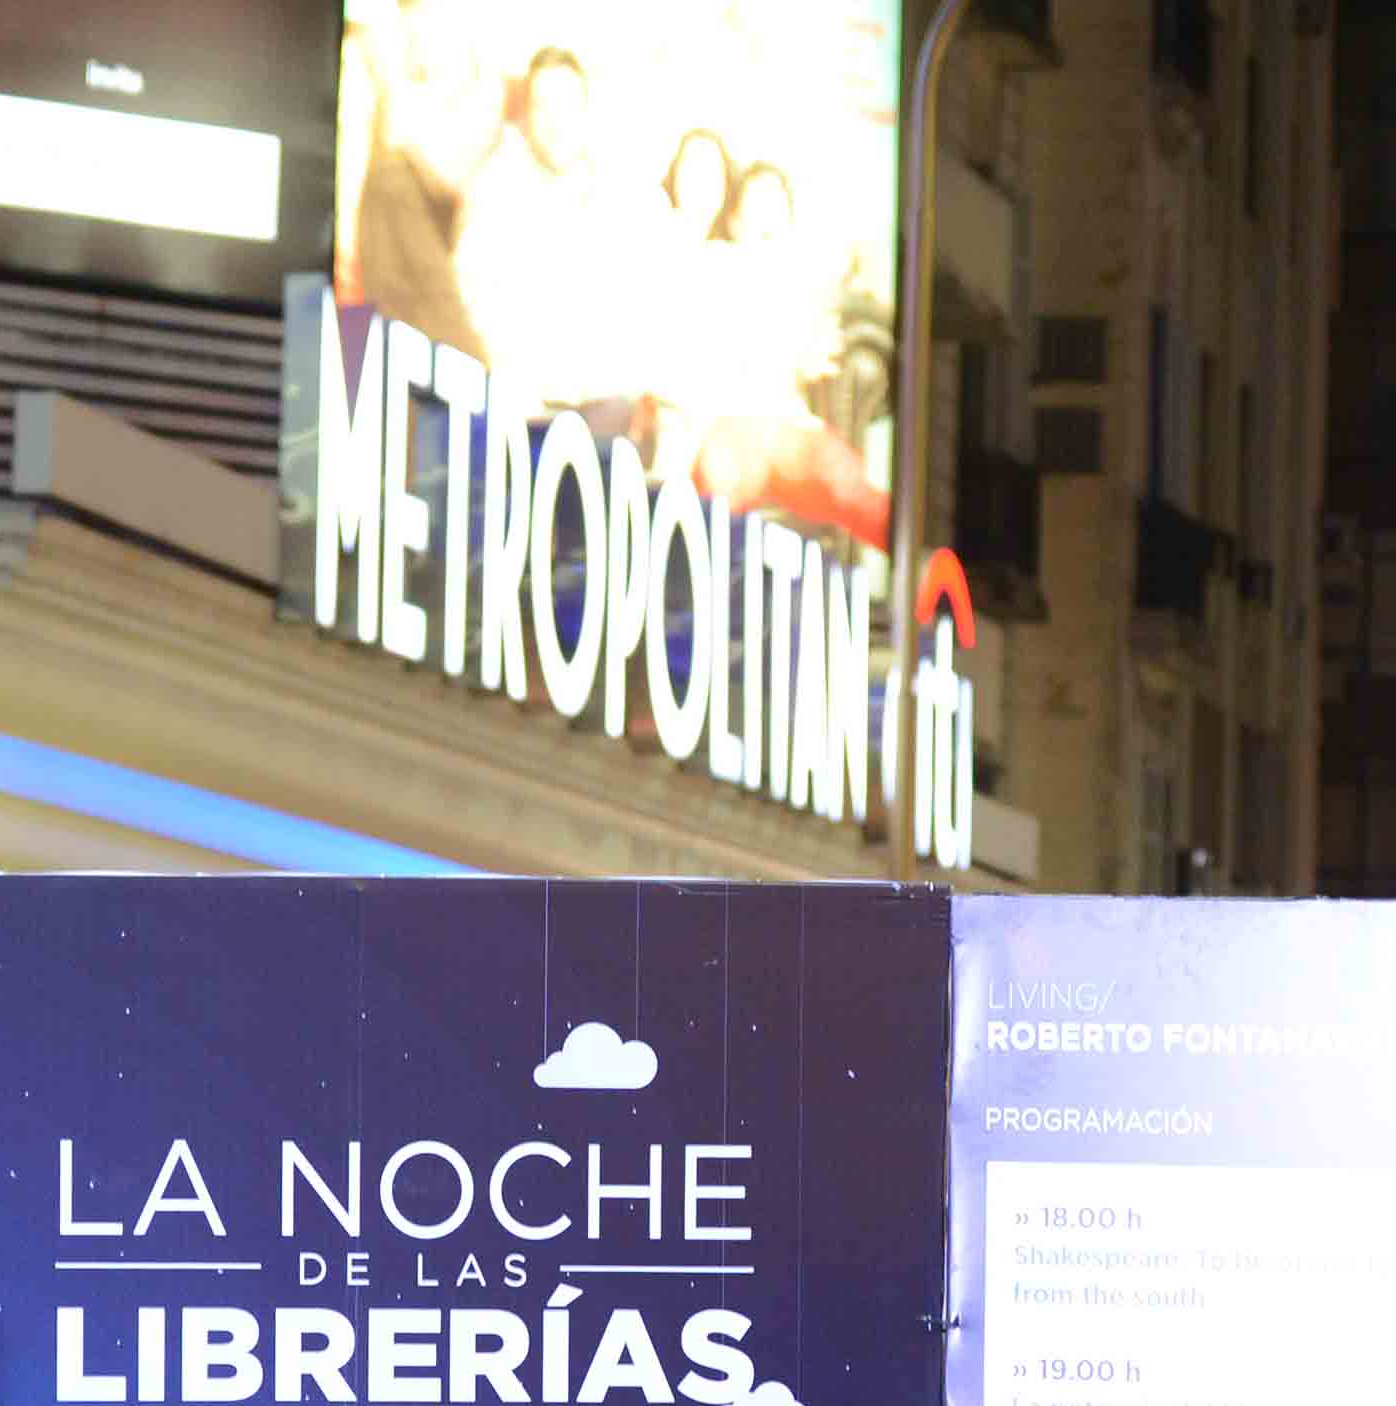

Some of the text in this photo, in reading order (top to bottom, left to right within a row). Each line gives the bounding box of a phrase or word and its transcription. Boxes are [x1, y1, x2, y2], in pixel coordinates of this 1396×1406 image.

[315, 285, 868, 822] METROPOLITAN
[988, 981, 1117, 1014] LIVING/
[987, 1022, 1152, 1053] ROBERTO
[985, 1106, 1214, 1136] PROGRAMACIÓN
[57, 1138, 753, 1241] LA NOCHE
[1041, 1206, 1117, 1229] 18.00
[1127, 1206, 1142, 1230] h
[298, 1252, 529, 1288] DE LAS
[56, 1283, 756, 1406] LIBRERÍAS
[1038, 1358, 1115, 1382] 19.00
[1126, 1358, 1142, 1384] h
